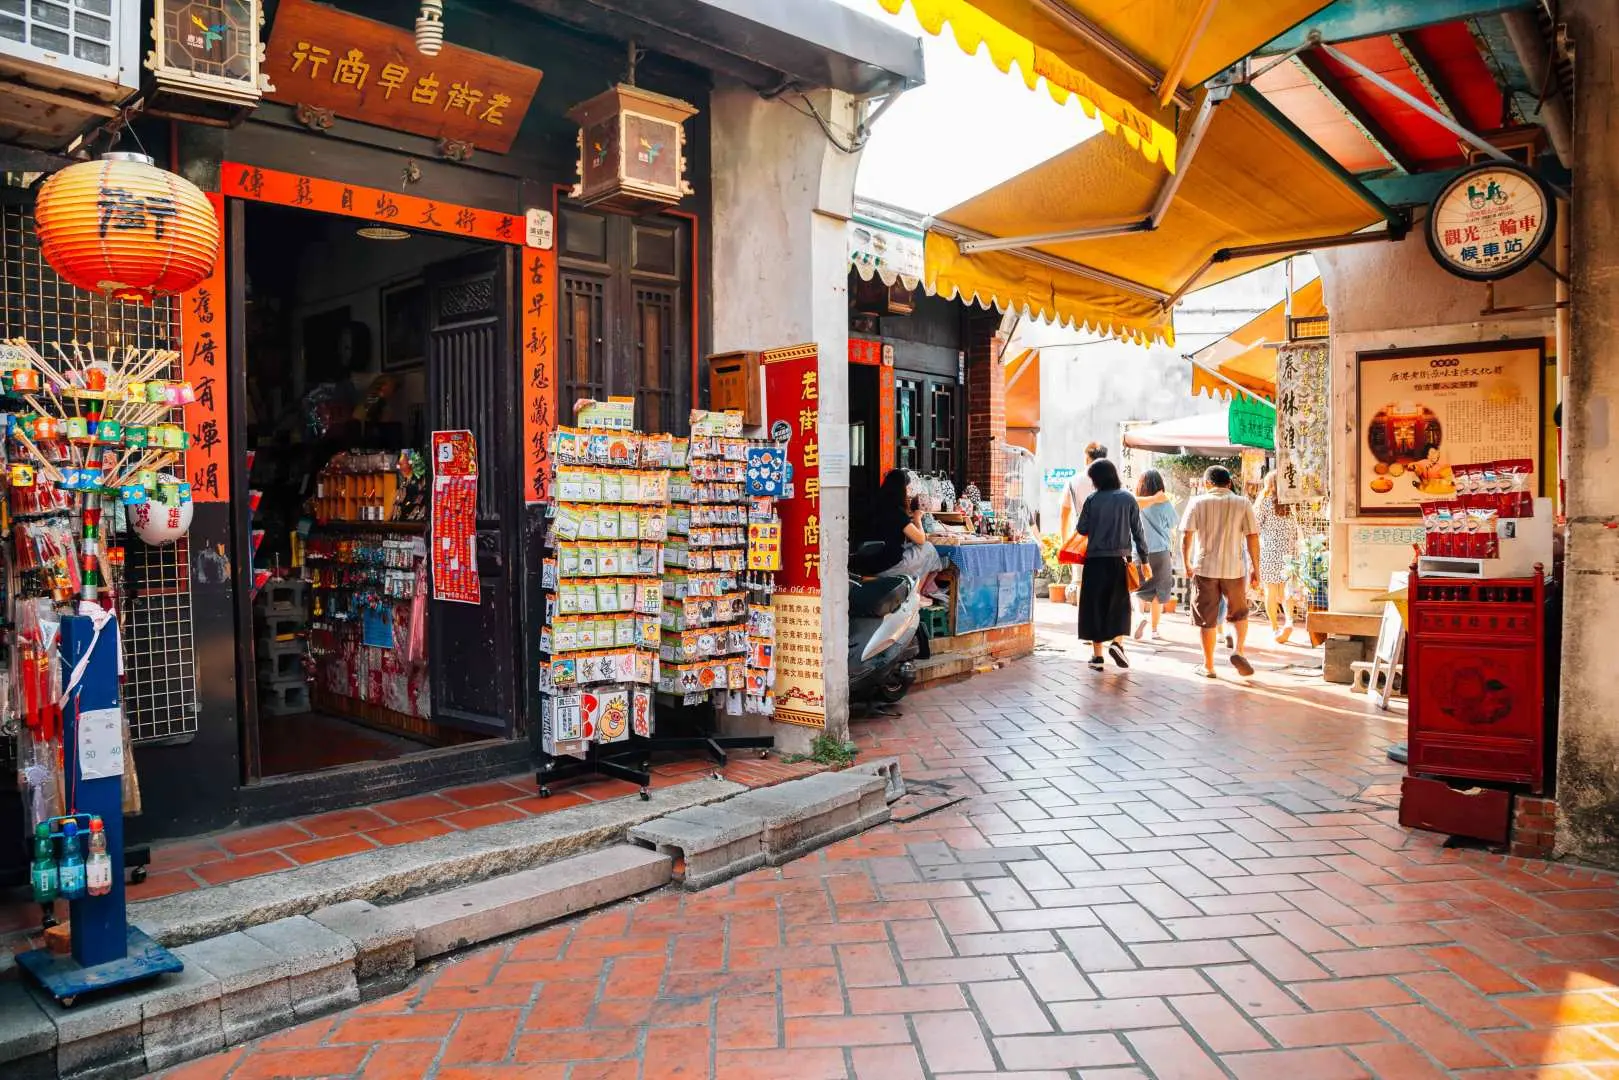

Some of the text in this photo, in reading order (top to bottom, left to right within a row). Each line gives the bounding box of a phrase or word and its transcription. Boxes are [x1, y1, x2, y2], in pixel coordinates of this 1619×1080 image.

[291, 40, 513, 126] 老街古早商行
[1460, 238, 1523, 262] 候車站
[442, 446, 450, 460] 5
[798, 370, 820, 579] 老街古早商行
[791, 585, 804, 594] Old
